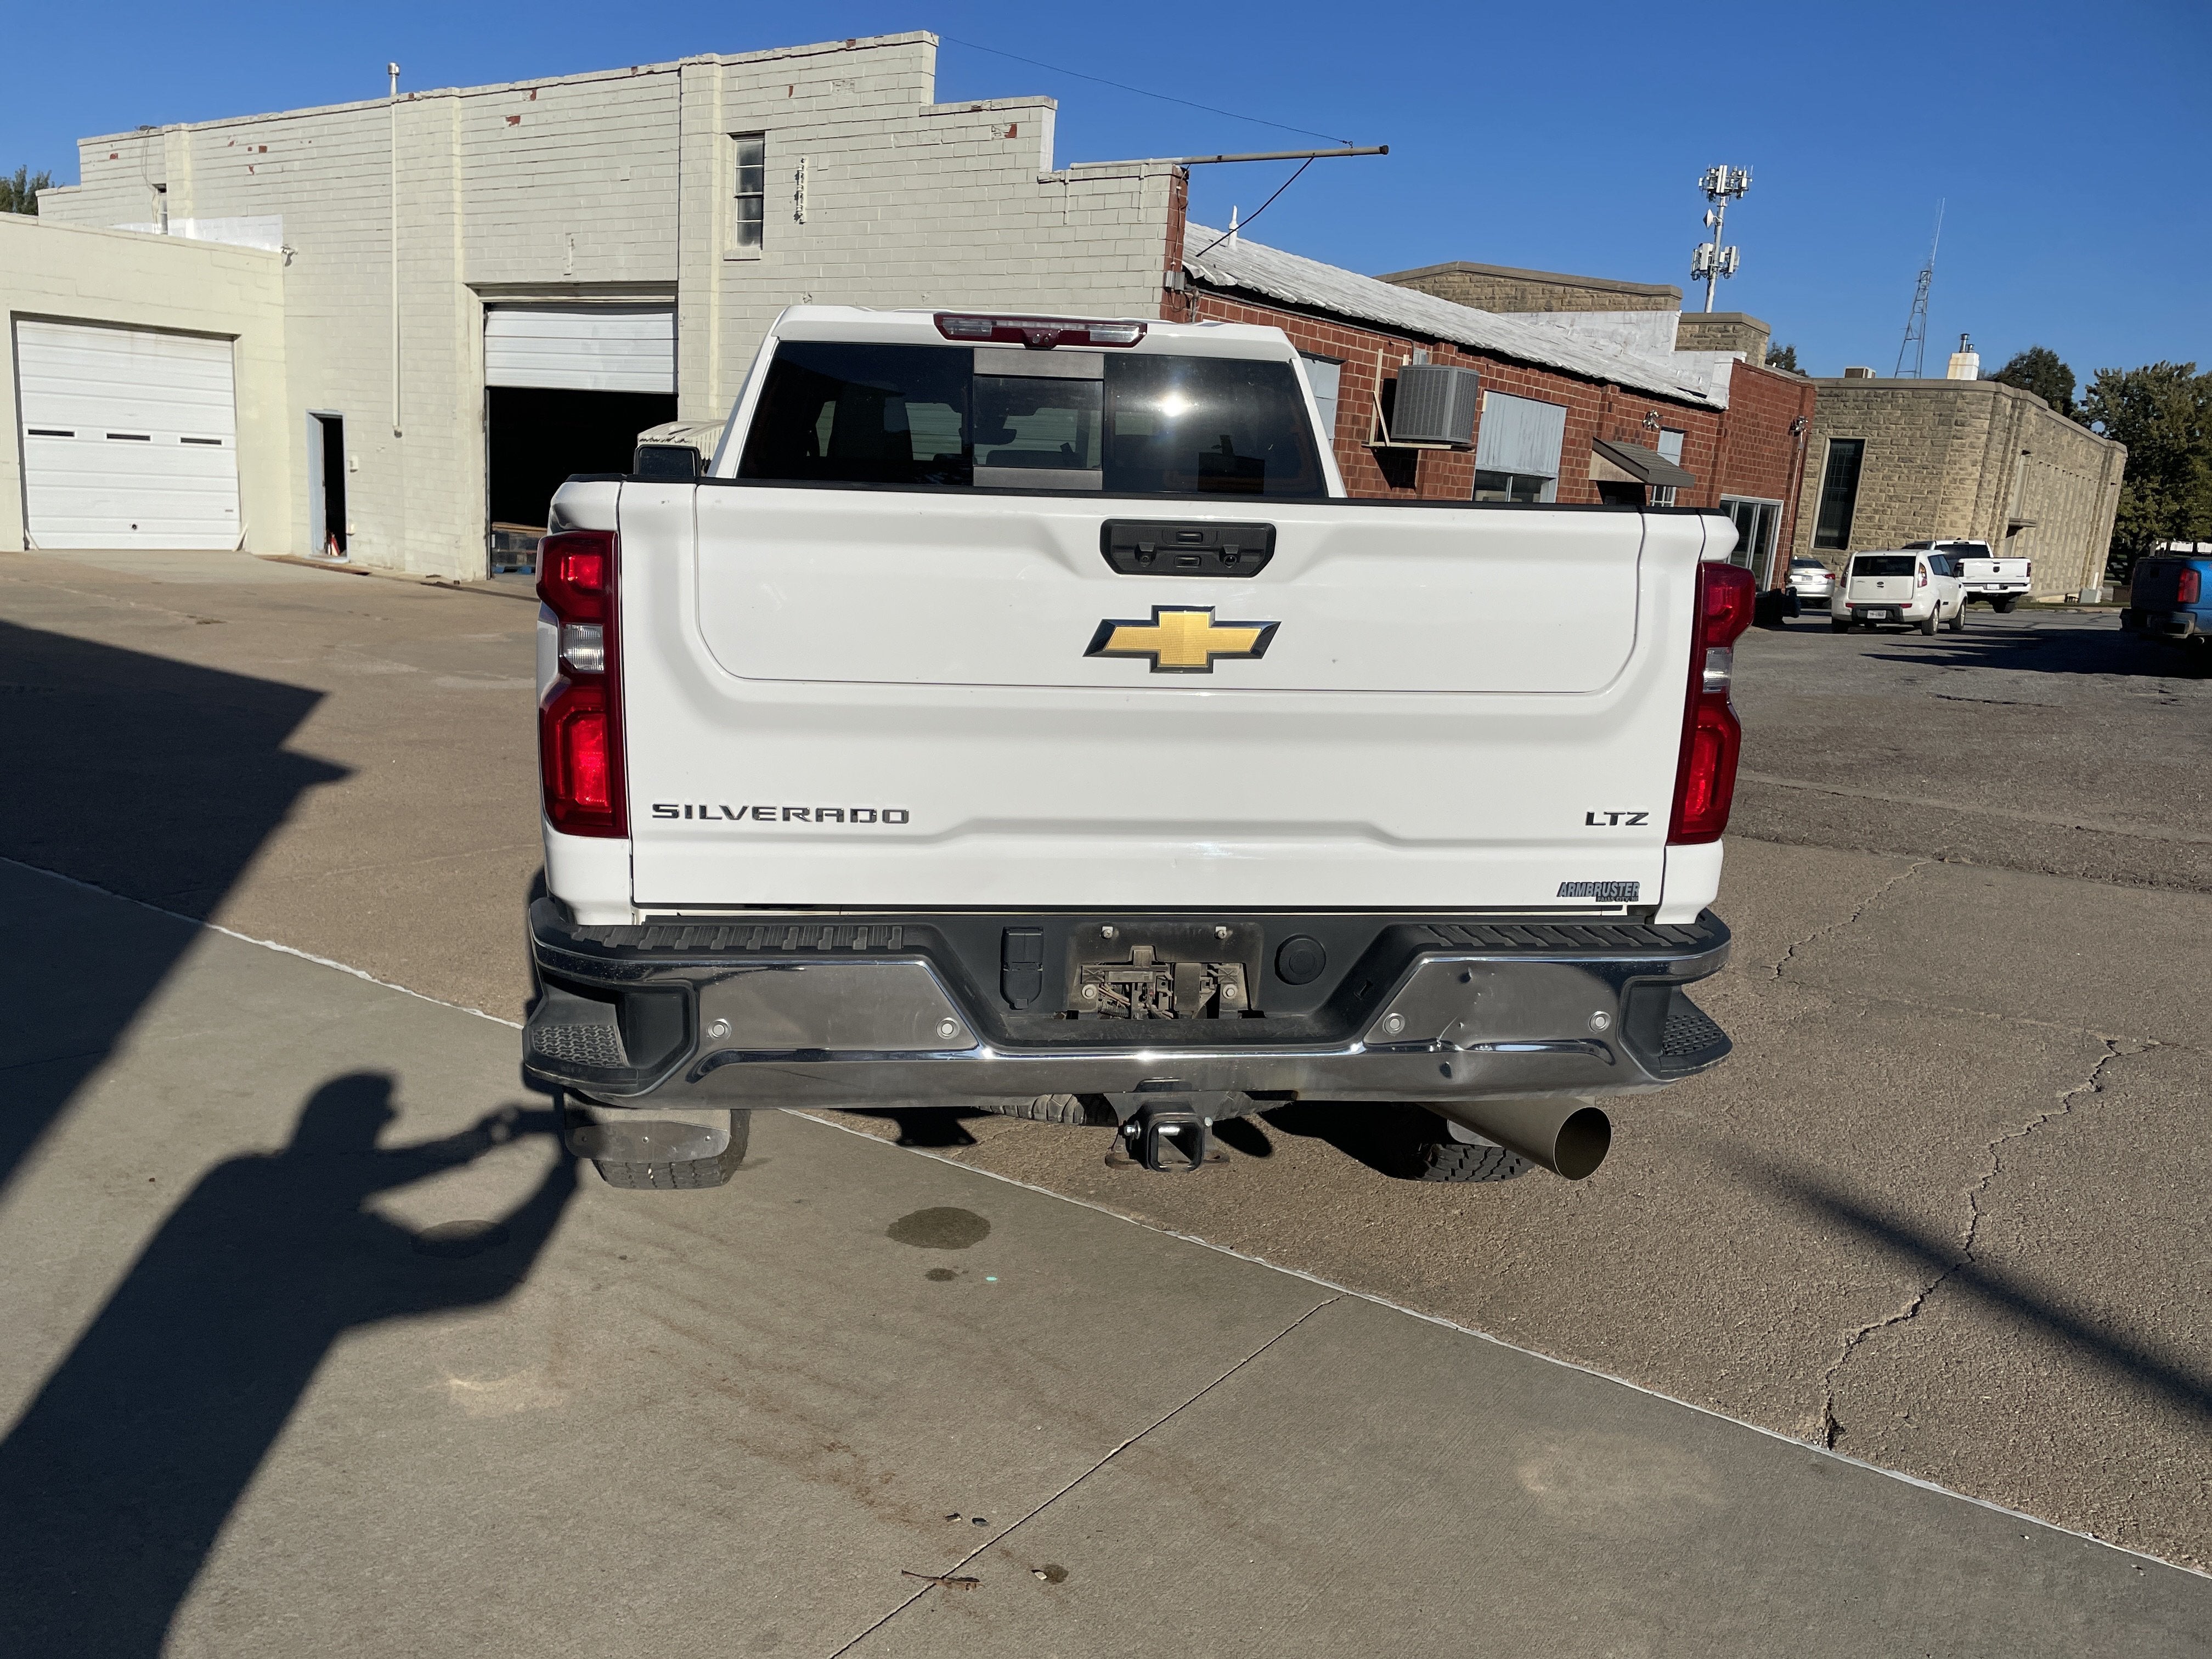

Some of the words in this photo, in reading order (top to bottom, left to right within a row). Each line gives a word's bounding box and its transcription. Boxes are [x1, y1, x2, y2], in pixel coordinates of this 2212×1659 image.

[652, 803, 910, 824] SILVERADO
[1585, 811, 1649, 826] LTZ
[1558, 881, 1639, 897] ARMBRUSTER
